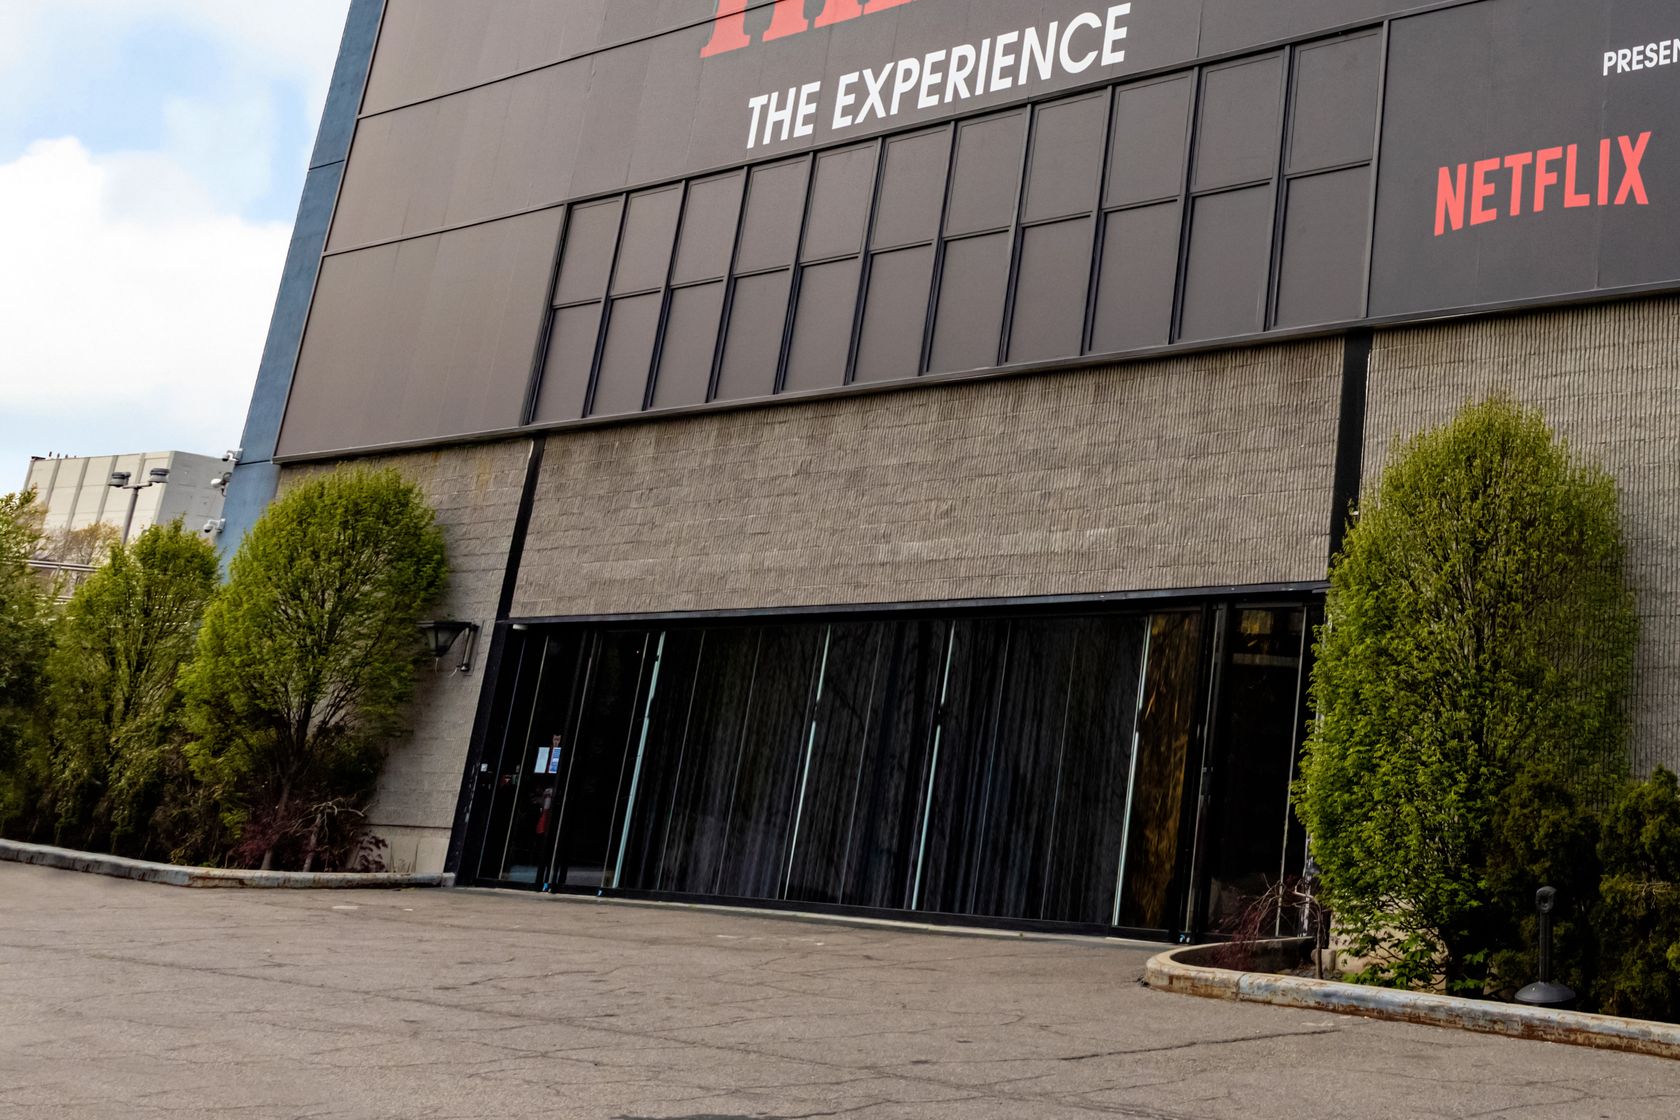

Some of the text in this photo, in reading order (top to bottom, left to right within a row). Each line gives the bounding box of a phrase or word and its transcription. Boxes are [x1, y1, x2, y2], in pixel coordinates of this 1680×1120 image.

[745, 1, 1132, 150] THE EXPERIENCE
[1433, 131, 1652, 237] NETFLIX
